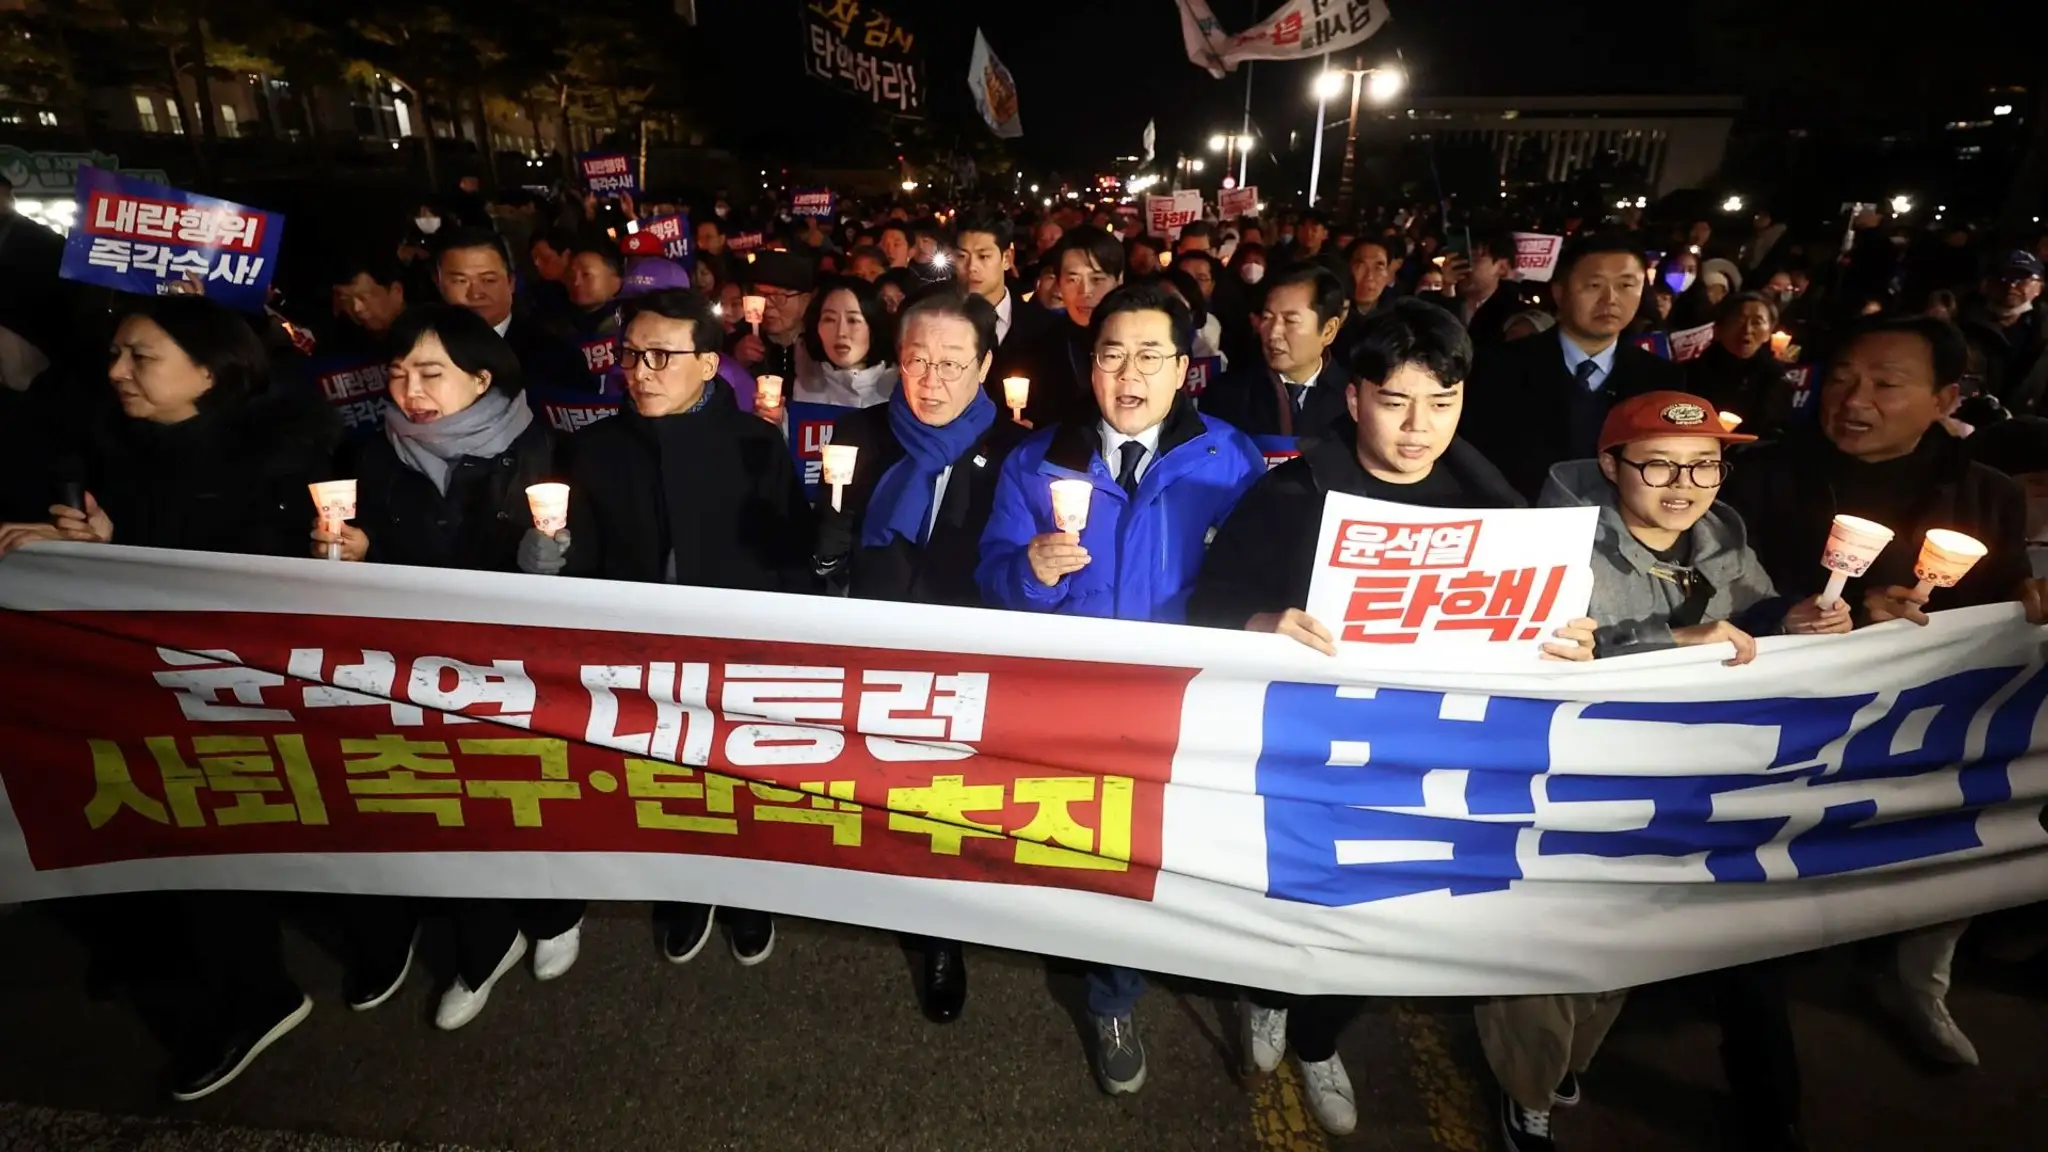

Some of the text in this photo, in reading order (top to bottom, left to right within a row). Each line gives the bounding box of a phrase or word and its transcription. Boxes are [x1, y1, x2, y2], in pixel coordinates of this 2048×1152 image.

[808, 0, 859, 38] 작
[810, 23, 918, 111] 탄핵하라!
[88, 237, 265, 286] 즉각수사!
[95, 197, 259, 248] 내란행위
[1337, 523, 1477, 566] 윤석열
[1340, 564, 1568, 644] 탄핵!
[152, 646, 990, 767] 윤석열 대통령
[84, 733, 330, 830] 사퇴
[887, 774, 1134, 872] 추진
[1256, 662, 2048, 907] 범국민
